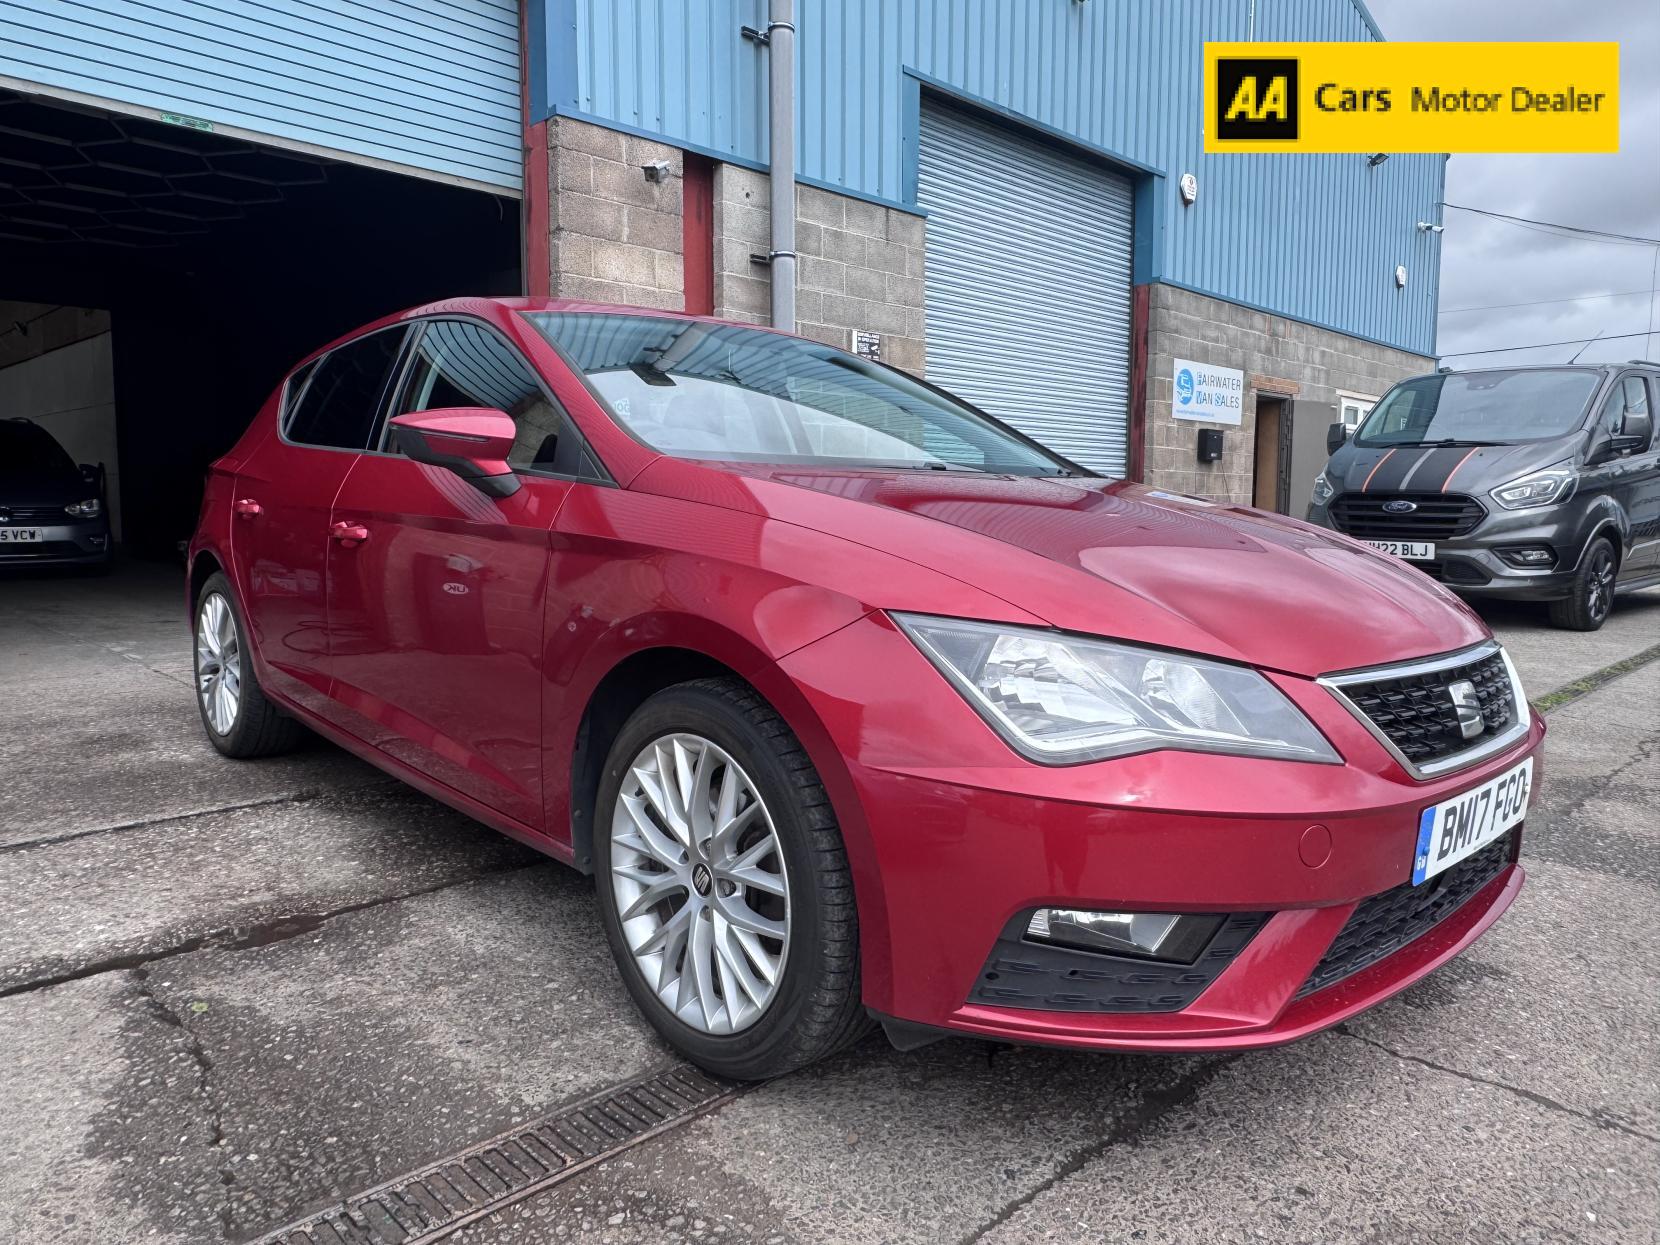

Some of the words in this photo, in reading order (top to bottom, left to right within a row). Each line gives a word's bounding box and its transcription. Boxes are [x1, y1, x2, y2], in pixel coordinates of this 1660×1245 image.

[1215, 393, 1240, 408] SALES
[1401, 544, 1428, 556] BLJ
[1436, 787, 1492, 862] BM17
[1490, 767, 1527, 832] FGO
